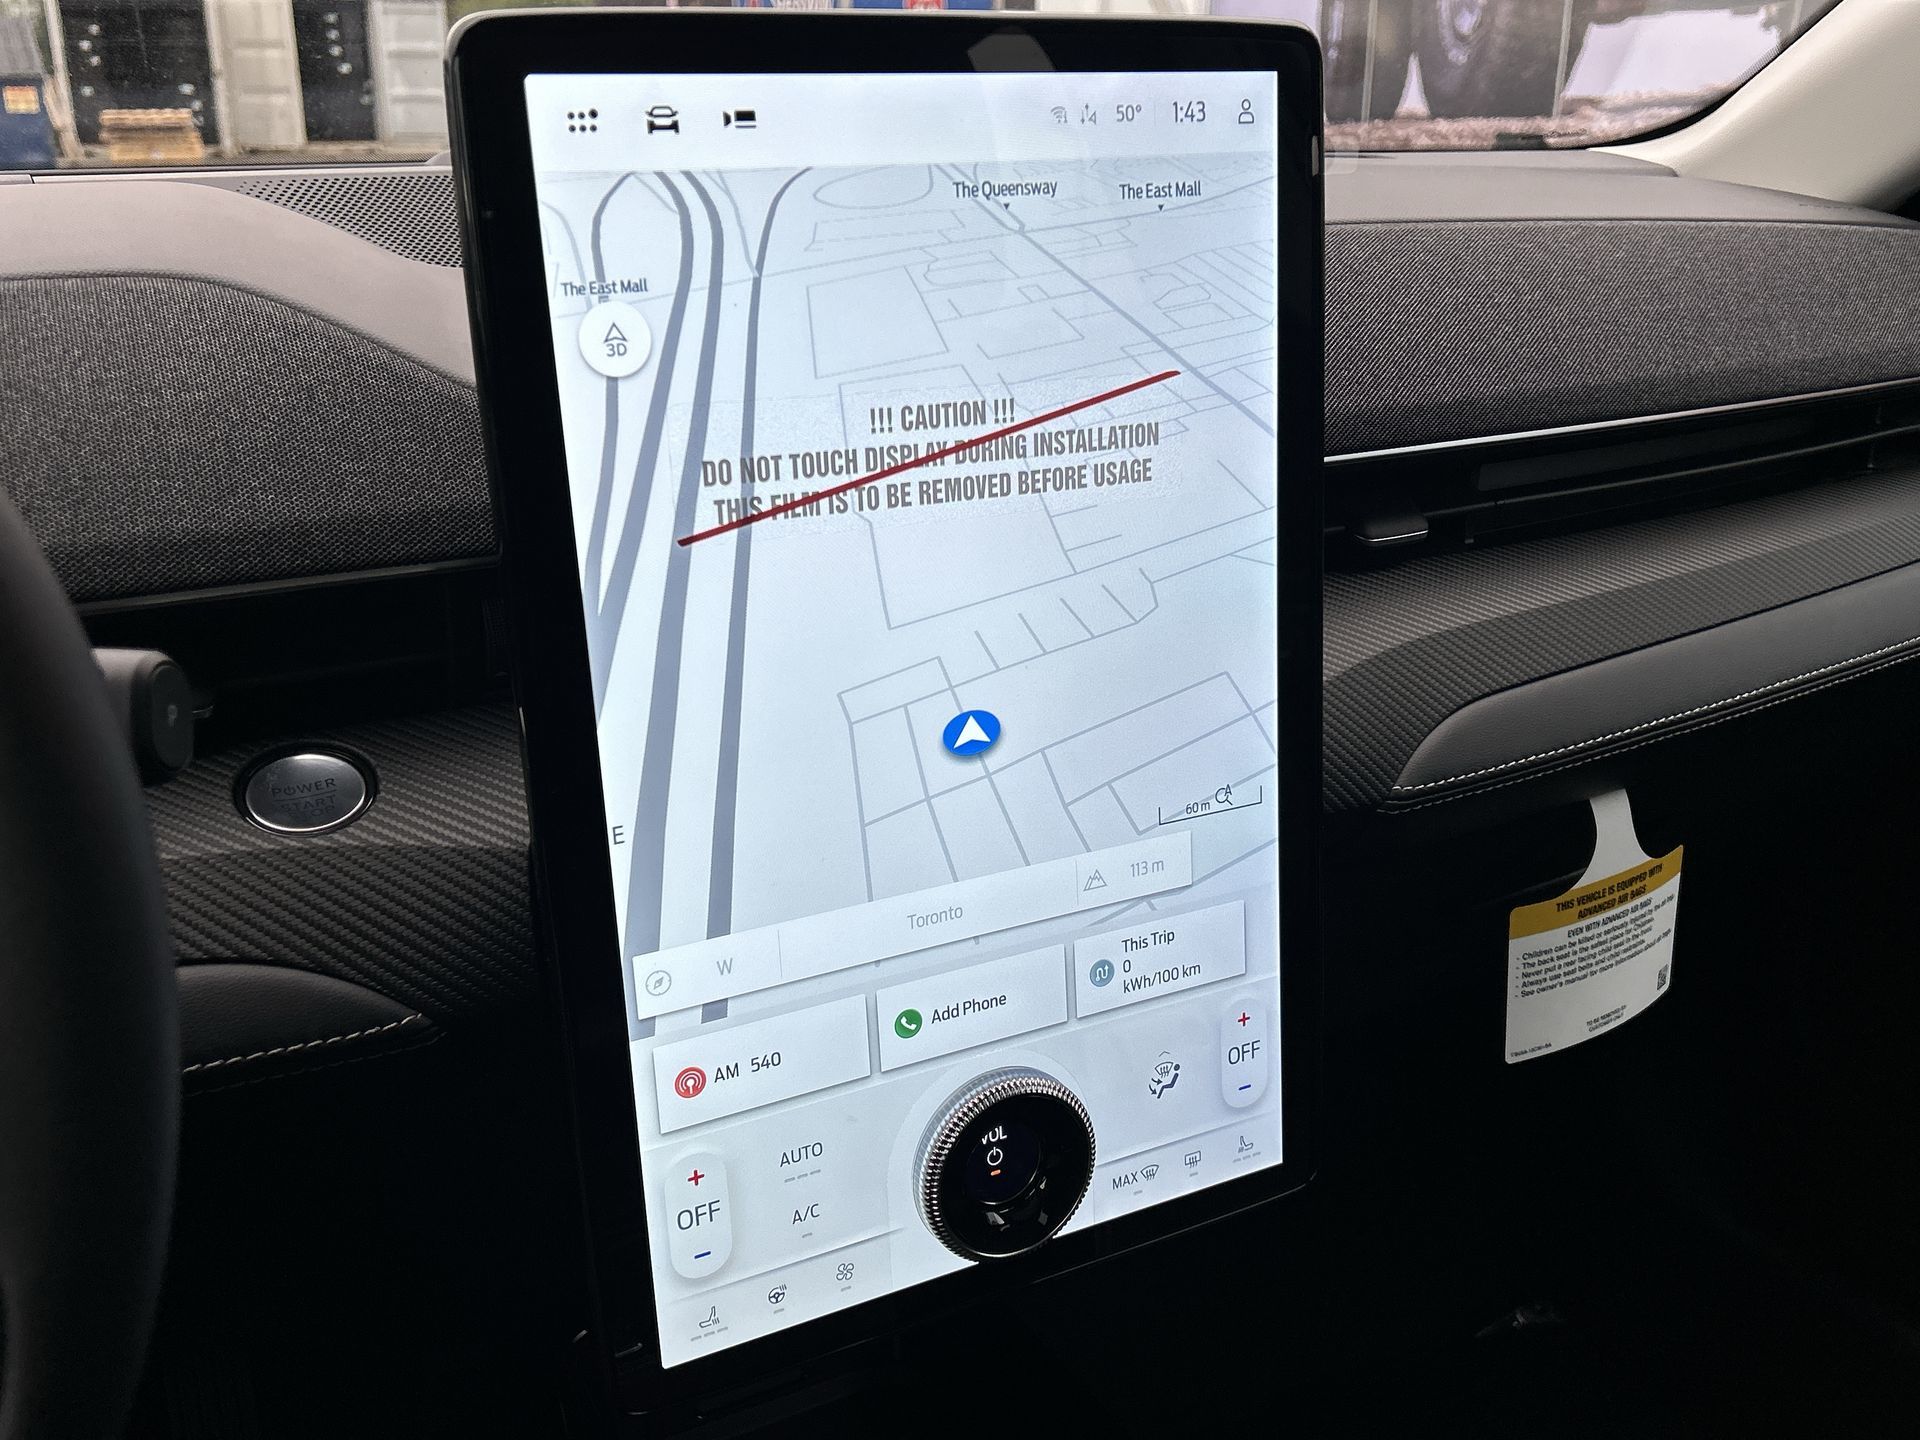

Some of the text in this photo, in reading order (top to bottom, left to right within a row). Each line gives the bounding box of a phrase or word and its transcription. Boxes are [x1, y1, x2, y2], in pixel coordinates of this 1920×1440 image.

[1172, 101, 1206, 123] 1:43
[953, 180, 1058, 200] The Queensway
[1119, 180, 1201, 200] The East Mall
[560, 277, 648, 296] The East Mall
[606, 343, 627, 357] 3D
[870, 398, 1015, 434] !!! CAUTION !!!
[703, 422, 1160, 487] DO NOT TOUCH DISPLAY DURING INSTALLATION
[714, 458, 1152, 526] THIS FILM IS TO BE REMOVED BEFORE USAGE
[271, 778, 337, 797] POWER
[1185, 802, 1200, 815] 60
[612, 825, 625, 845] E
[1130, 860, 1165, 878] 113 m
[1556, 863, 1663, 912] THIS VEHICLE IS EQUIPPED WITH
[1577, 897, 1616, 920] ADVANCED
[1617, 892, 1629, 905] AIR
[907, 905, 963, 931] Toronto
[1121, 930, 1175, 954] This Trip
[1567, 926, 1584, 938] EVEN
[1521, 948, 1553, 961] Children
[1554, 944, 1567, 953] can
[1568, 941, 1577, 949] be
[1578, 934, 1595, 945] killed
[716, 957, 733, 976] W
[1122, 959, 1132, 974] 0
[1522, 961, 1536, 970] The
[1537, 955, 1555, 966] back
[1556, 951, 1570, 961] seat
[1122, 962, 1202, 995] kWh/100 km
[1521, 969, 1544, 979] Never
[1544, 964, 1557, 975] put
[1521, 977, 1547, 989] Always
[1549, 973, 1562, 981] use
[1563, 967, 1577, 977] seat
[1521, 989, 1535, 998] See
[930, 993, 1007, 1024] Add Phone
[1228, 1040, 1261, 1065] OFF
[714, 1051, 782, 1083] AM 540
[779, 1142, 823, 1168] AUTO
[1112, 1170, 1138, 1190] MAX
[676, 1199, 721, 1231] OFF
[792, 1203, 820, 1224] A/C
